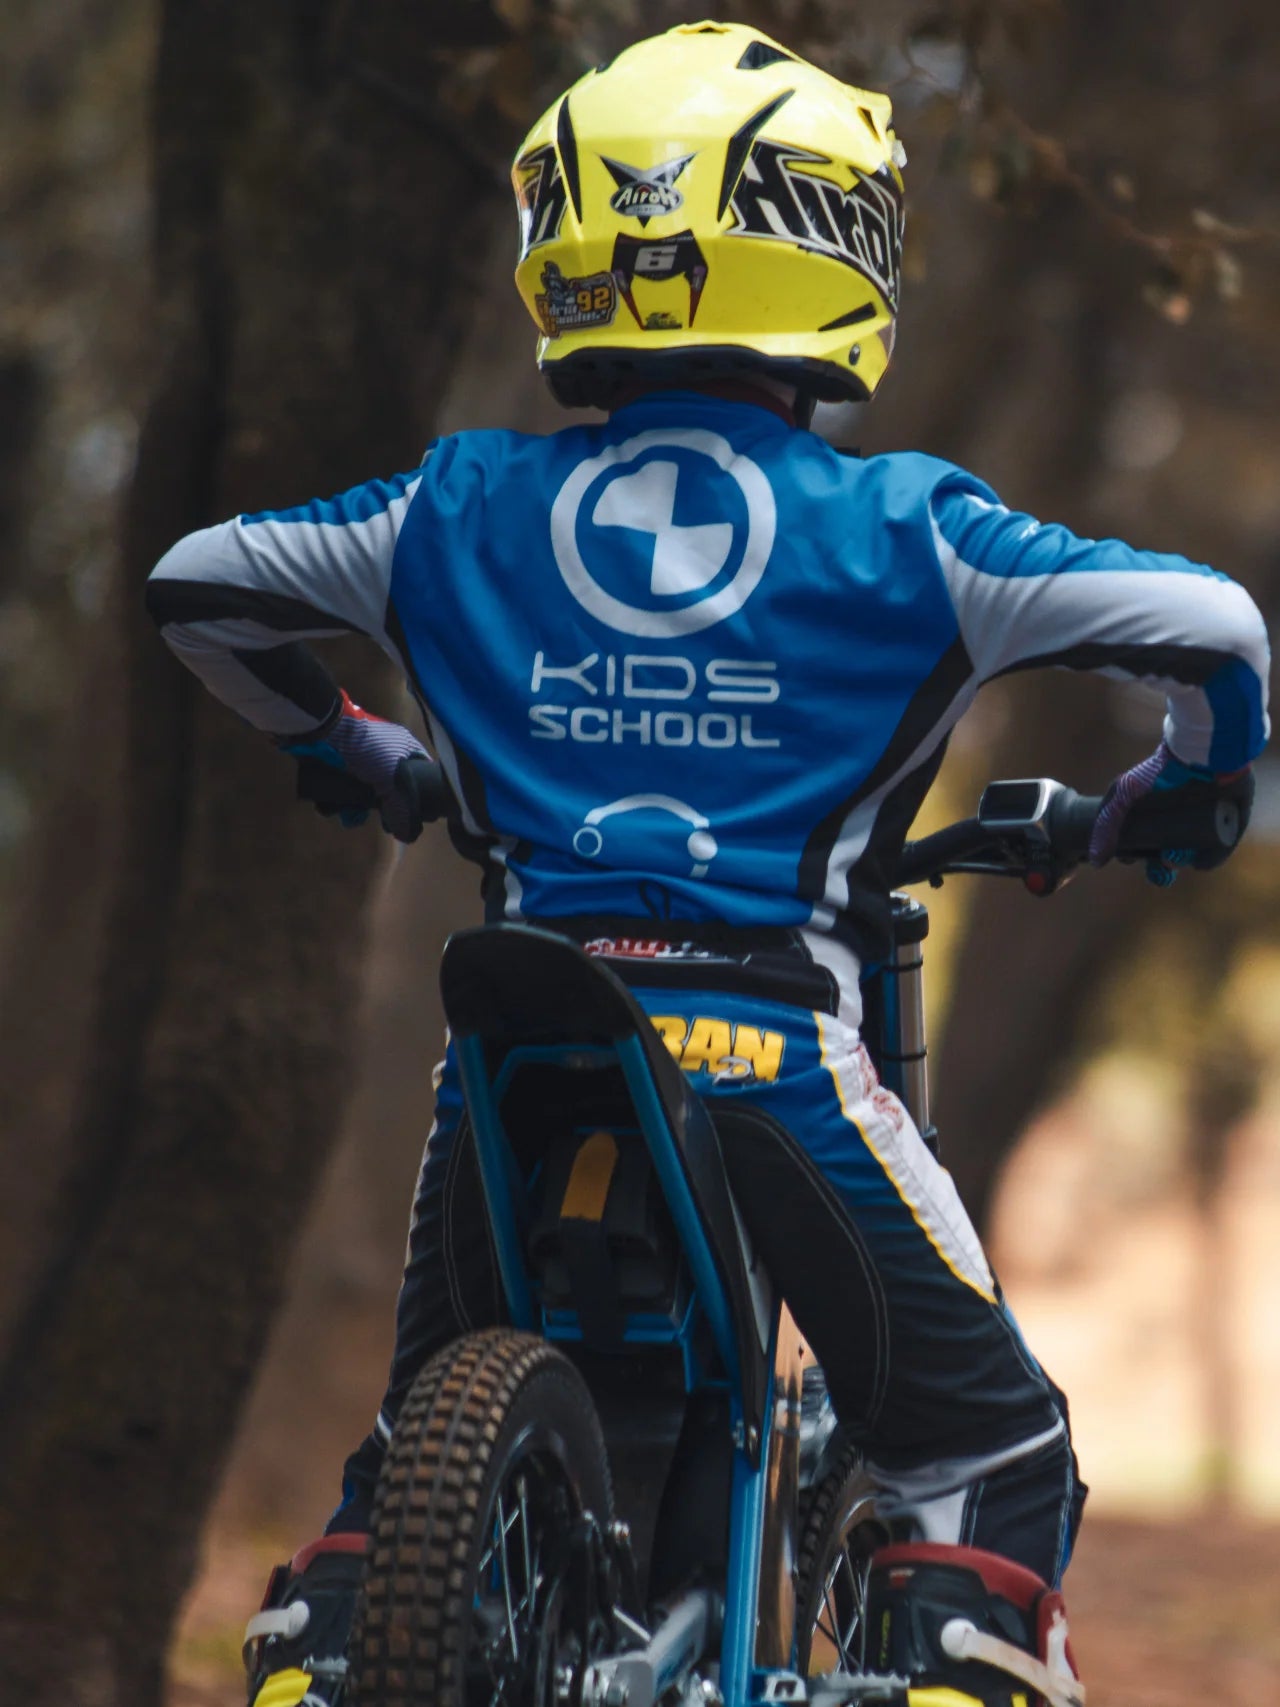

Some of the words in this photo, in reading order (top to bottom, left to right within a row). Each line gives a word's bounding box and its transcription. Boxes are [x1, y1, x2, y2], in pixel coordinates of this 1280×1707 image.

[576, 286, 610, 313] 92
[531, 650, 780, 703] KIDS
[528, 704, 780, 748] SCHOOL
